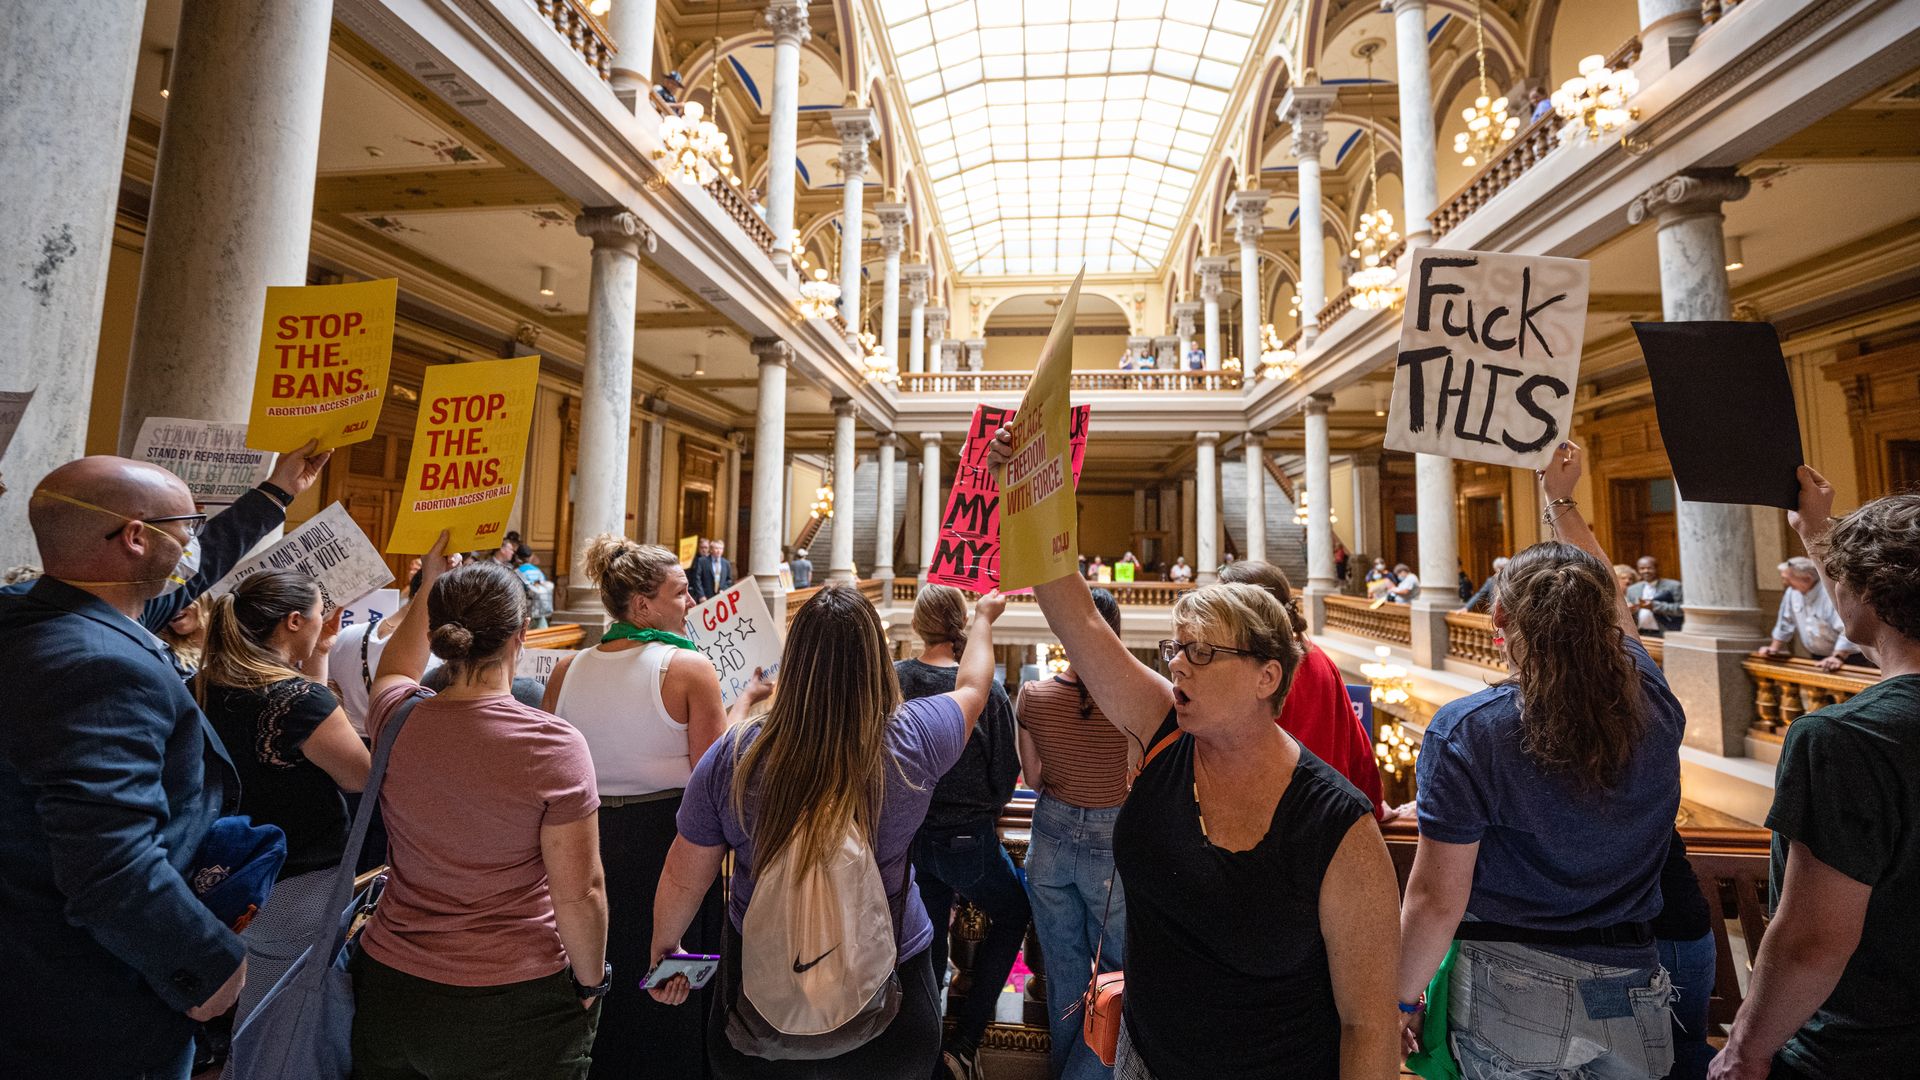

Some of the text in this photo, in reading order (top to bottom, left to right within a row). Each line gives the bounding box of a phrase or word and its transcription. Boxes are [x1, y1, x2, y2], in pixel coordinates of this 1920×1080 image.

[276, 312, 366, 340] STOP.
[274, 343, 348, 369] THE.
[271, 368, 369, 399] BANS.
[268, 389, 377, 416] ABORTION ACCESS FOR ALL
[429, 393, 507, 425] STOP.
[1397, 346, 1570, 453] THIS
[342, 420, 369, 435] ACLU
[427, 427, 488, 457] THE.
[147, 447, 262, 465] STAND BY REPRO FREEDOM
[1006, 433, 1047, 486] FREEDOM
[420, 458, 504, 491] BANS.
[1006, 458, 1063, 517] WITH FORCE.
[414, 485, 511, 512] ABORTION ACCESS FOR ALL
[475, 522, 500, 536] ACLU
[1052, 531, 1070, 556] ACLU
[268, 541, 302, 569] MAN'S
[298, 521, 335, 553] WORLD
[295, 557, 319, 578] WE
[314, 538, 350, 571] VOTE
[930, 539, 993, 579] MY
[703, 590, 740, 631] GOP
[536, 655, 552, 674] IT'S
